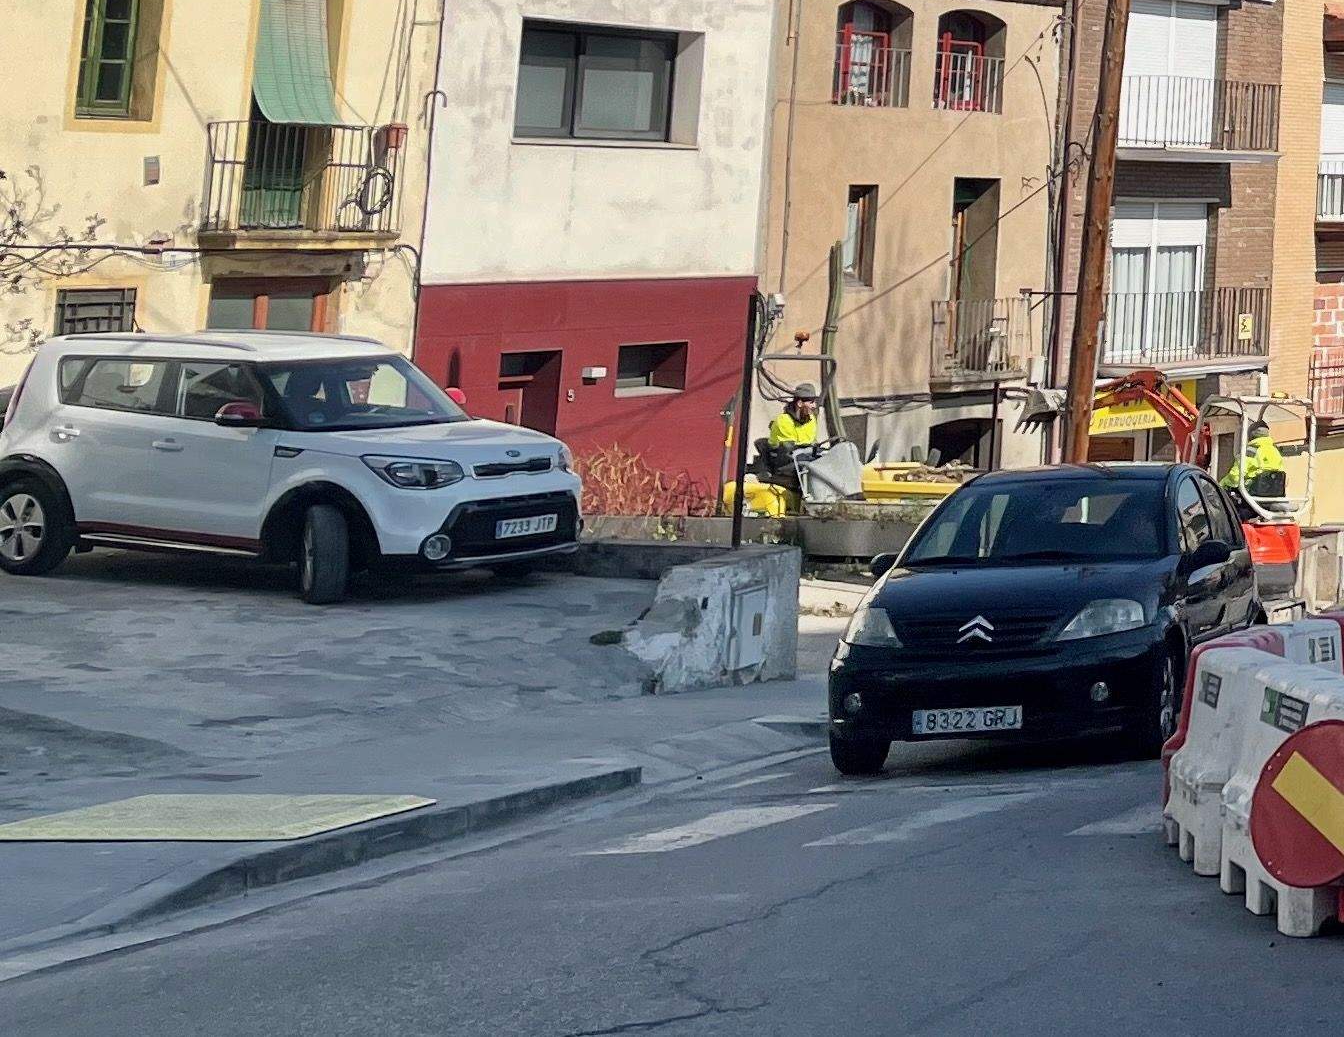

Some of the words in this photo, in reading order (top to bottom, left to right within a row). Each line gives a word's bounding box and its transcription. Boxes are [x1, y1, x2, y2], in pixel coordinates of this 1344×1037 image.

[566, 388, 576, 403] 5
[504, 519, 530, 535] 7233
[533, 516, 554, 532] JTP
[925, 710, 977, 731] 8322
[983, 707, 1018, 728] GRJ
